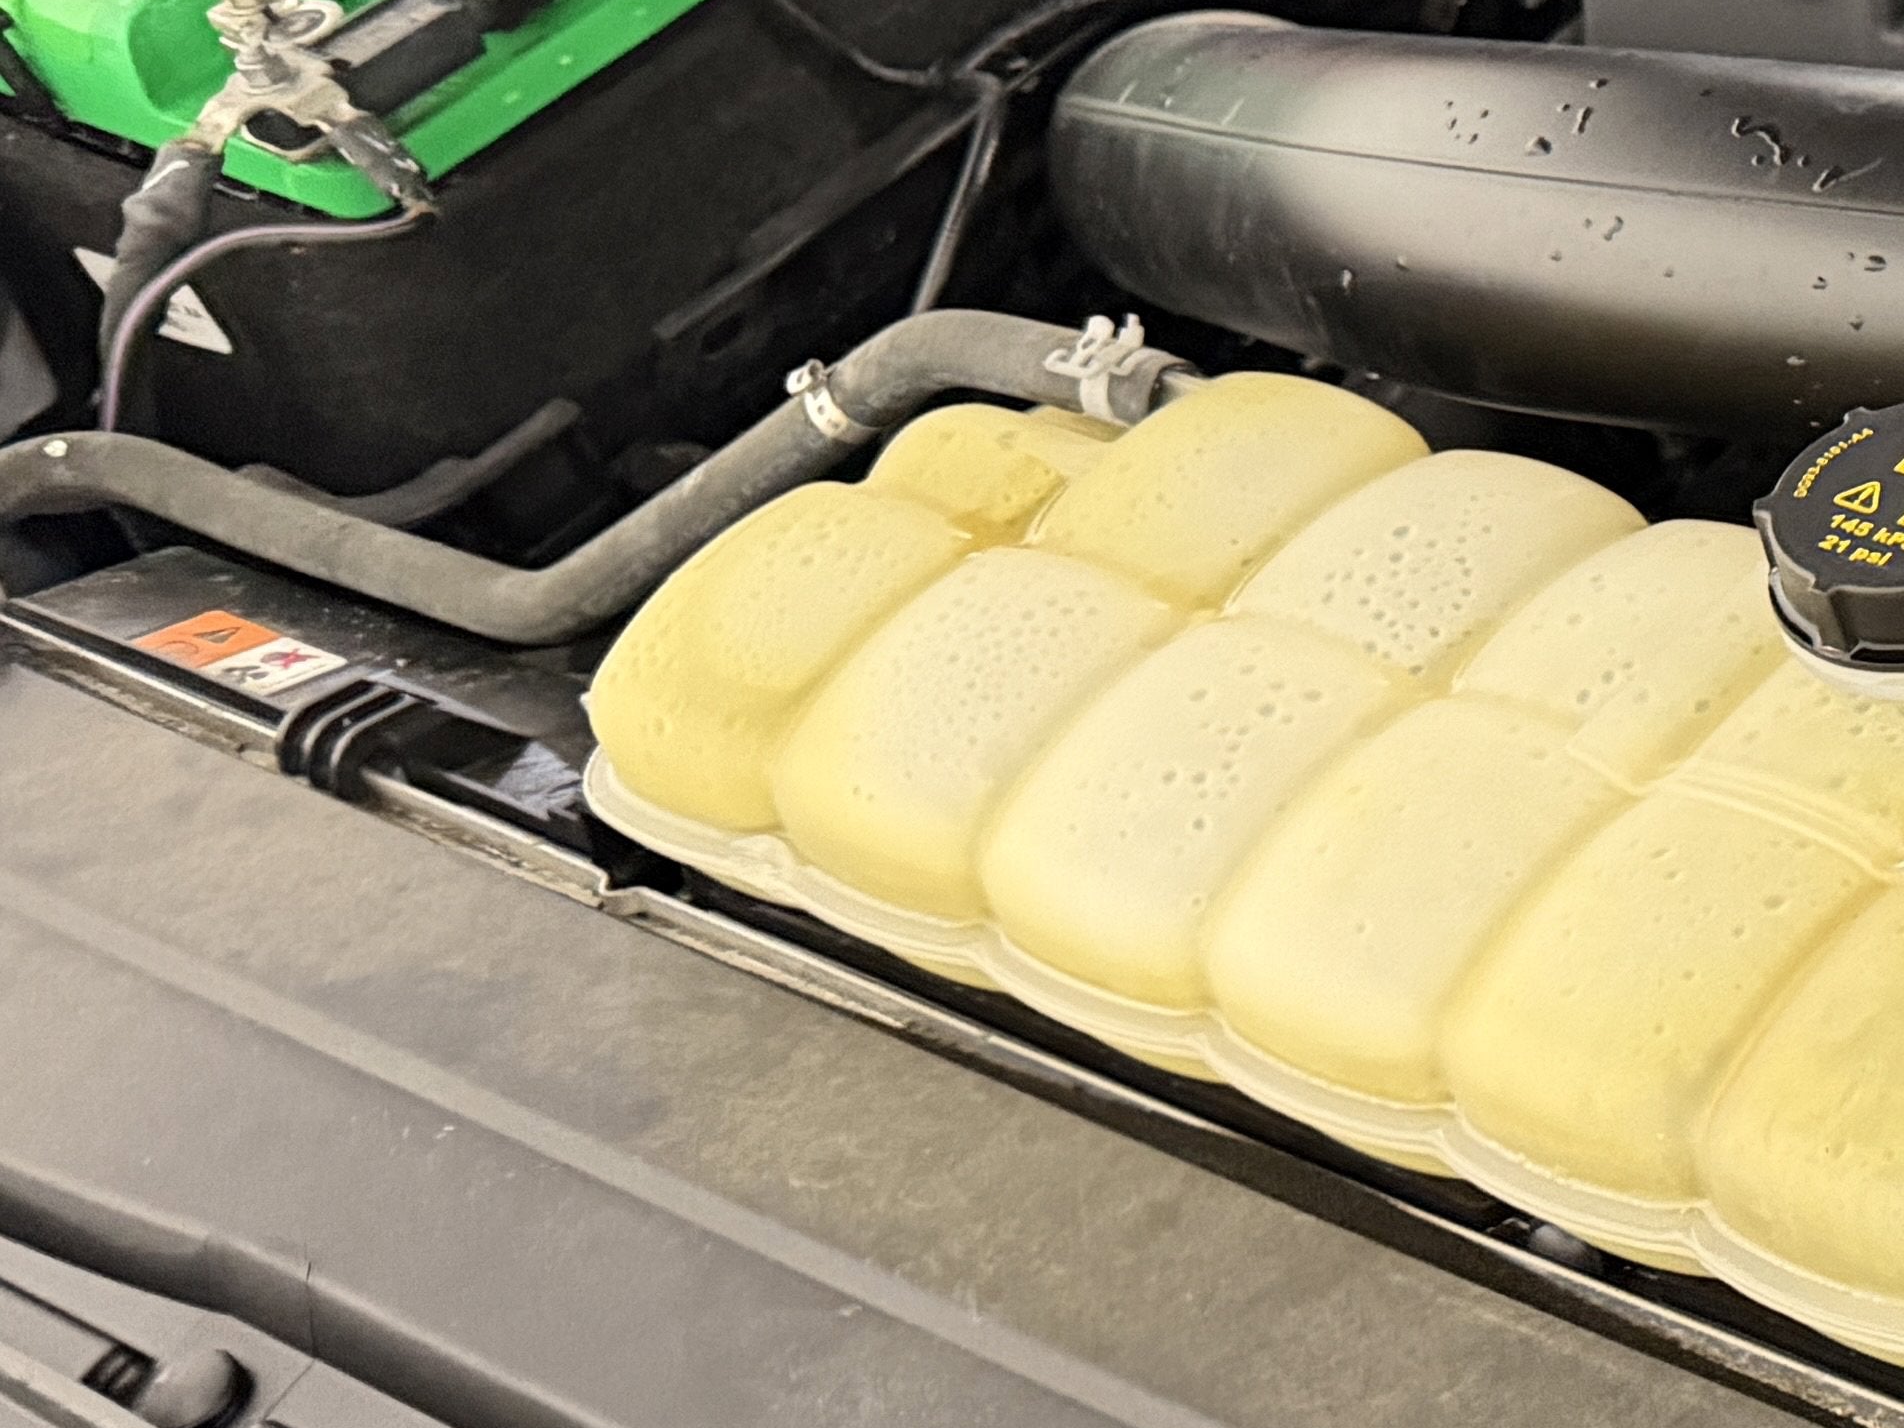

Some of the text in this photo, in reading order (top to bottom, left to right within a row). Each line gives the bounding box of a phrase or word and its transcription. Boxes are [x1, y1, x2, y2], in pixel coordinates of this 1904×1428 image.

[1830, 514, 1875, 538] 145
[1817, 535, 1893, 567] 21 psi
